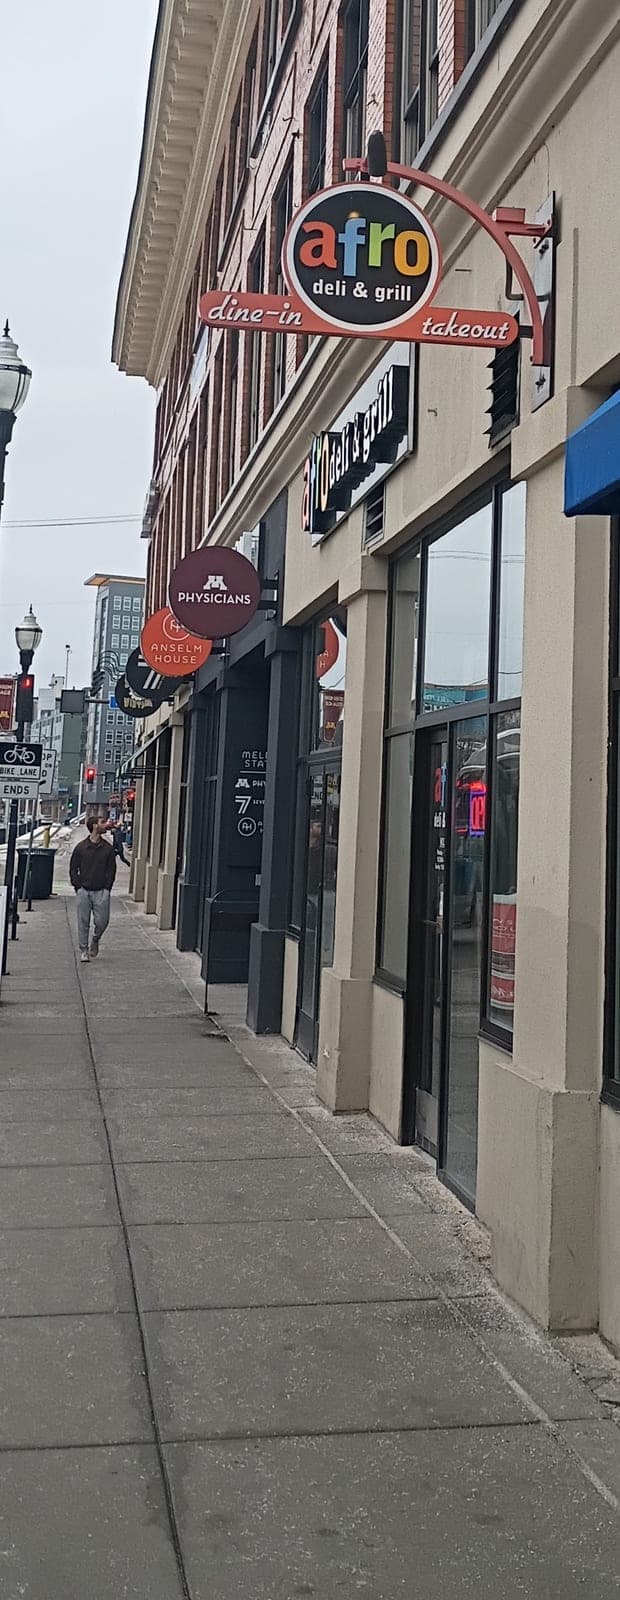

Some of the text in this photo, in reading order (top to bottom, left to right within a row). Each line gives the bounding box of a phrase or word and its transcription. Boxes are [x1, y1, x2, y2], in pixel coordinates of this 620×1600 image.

[299, 216, 430, 277] afro
[312, 279, 412, 302] deli & grill
[207, 294, 511, 341] dine-in takeout
[178, 591, 251, 605] PHYSICIANS
[151, 643, 202, 653] ANSELM
[155, 655, 197, 664] HOUSE
[244, 759, 267, 768] STA
[20, 767, 37, 776] LANE
[3, 785, 30, 795] ENDS
